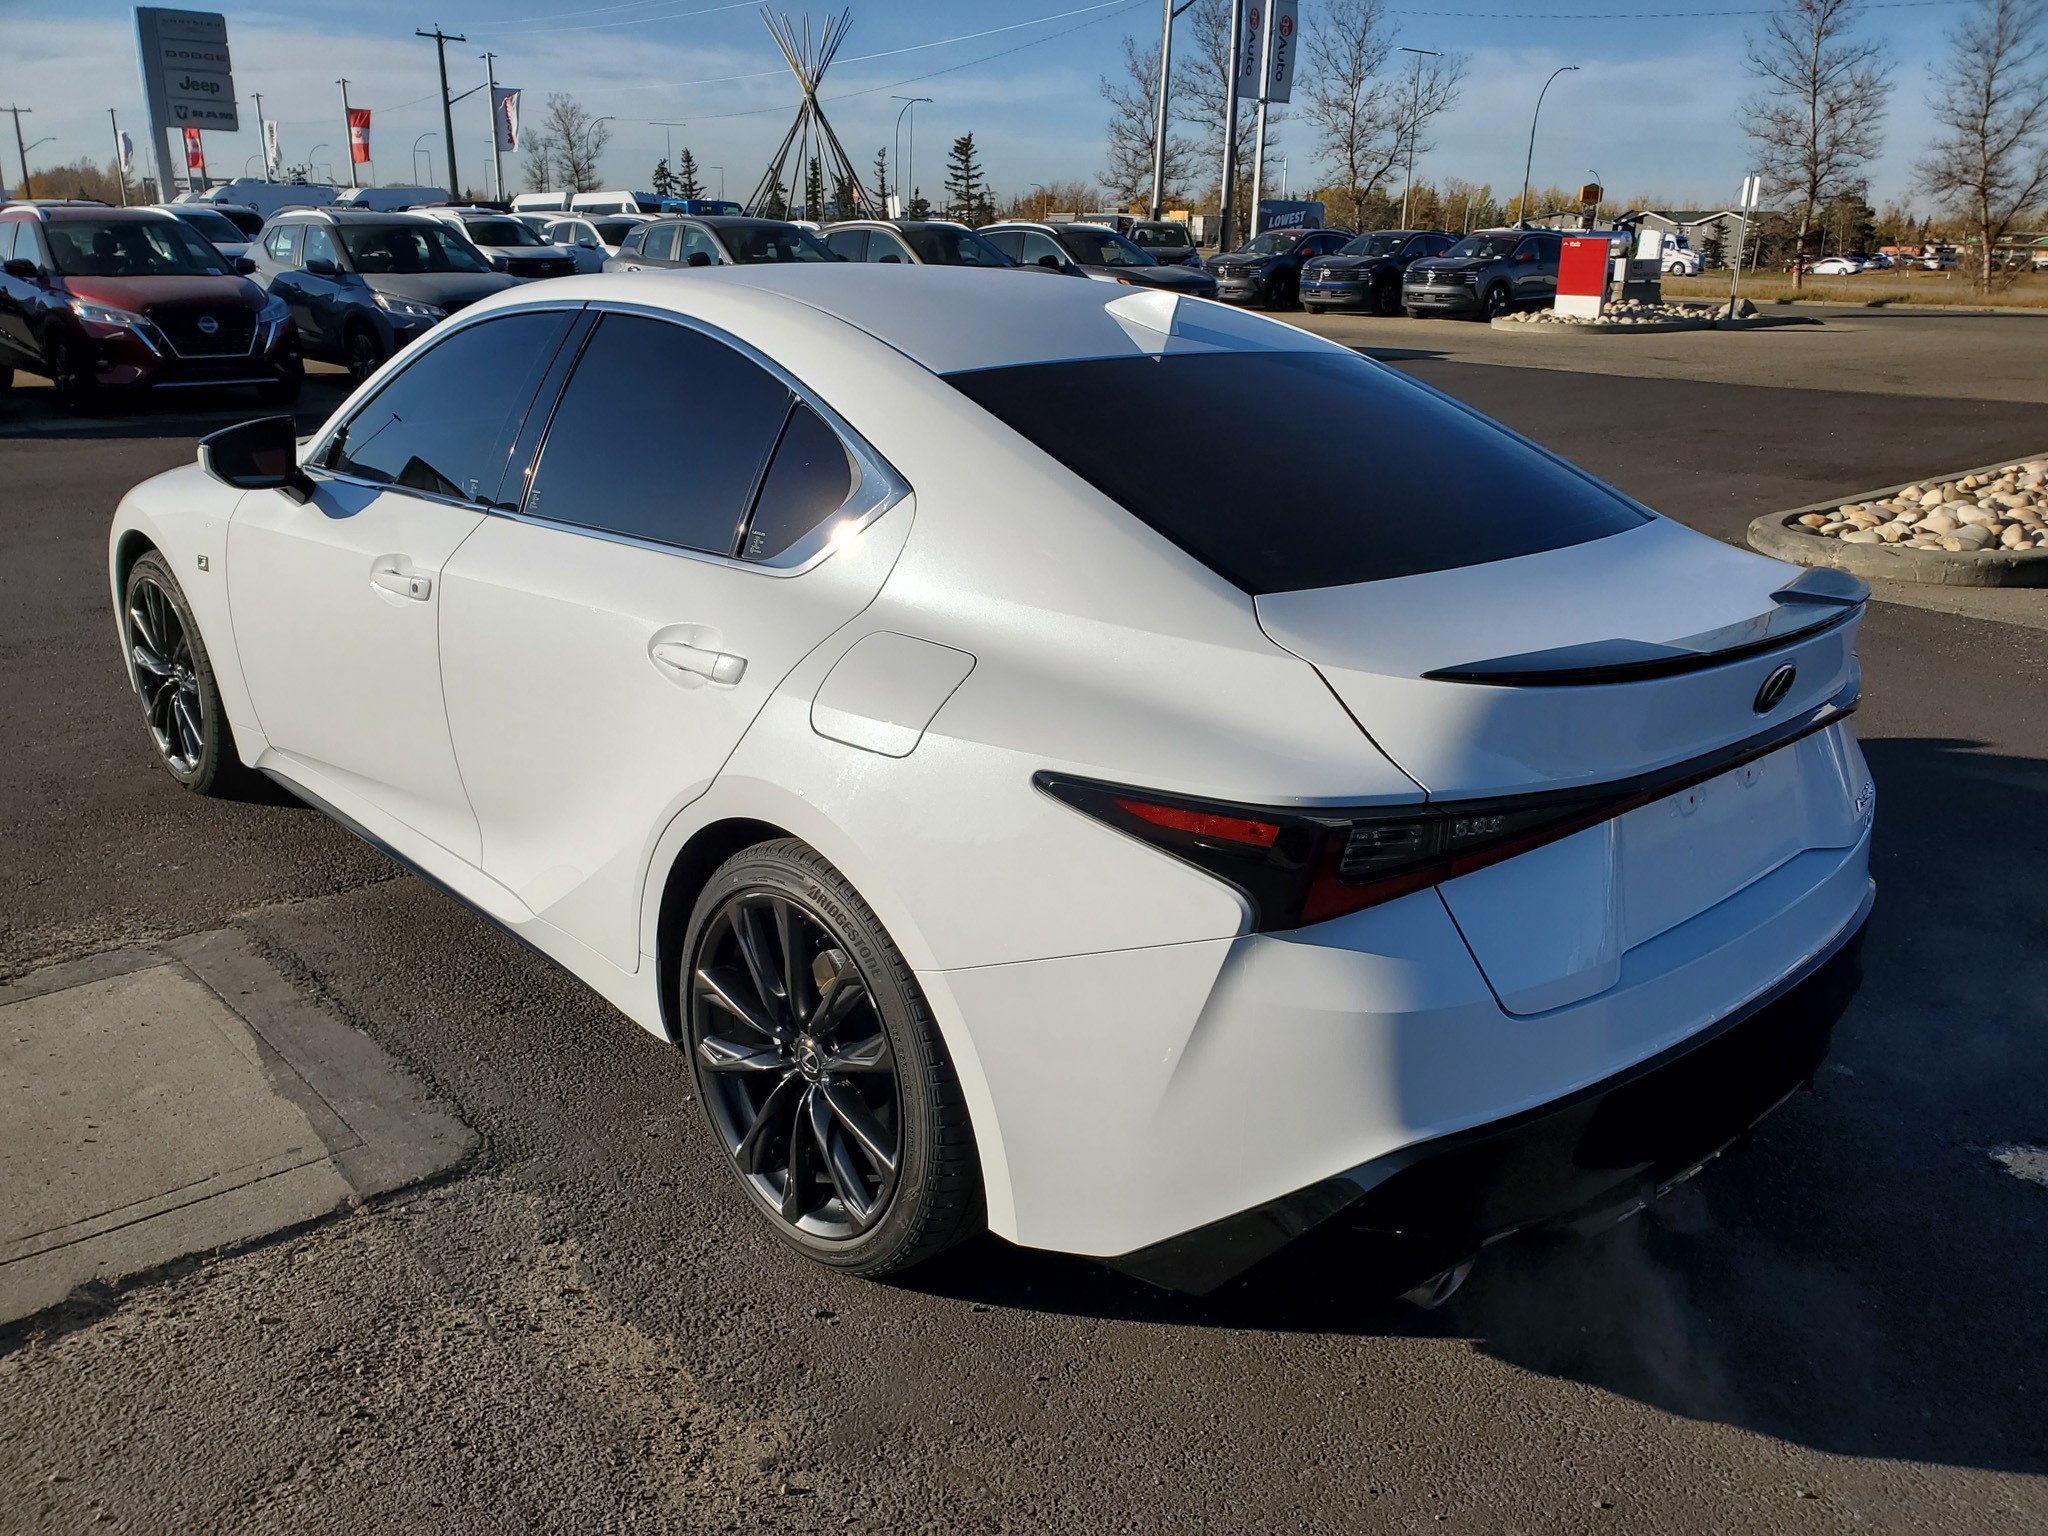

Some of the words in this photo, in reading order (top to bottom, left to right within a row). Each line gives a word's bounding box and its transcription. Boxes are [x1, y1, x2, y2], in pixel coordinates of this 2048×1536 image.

[165, 50, 227, 62] DODGE
[179, 75, 220, 95] Jeep
[191, 109, 234, 120] RAM
[1268, 210, 1307, 229] LOWEST
